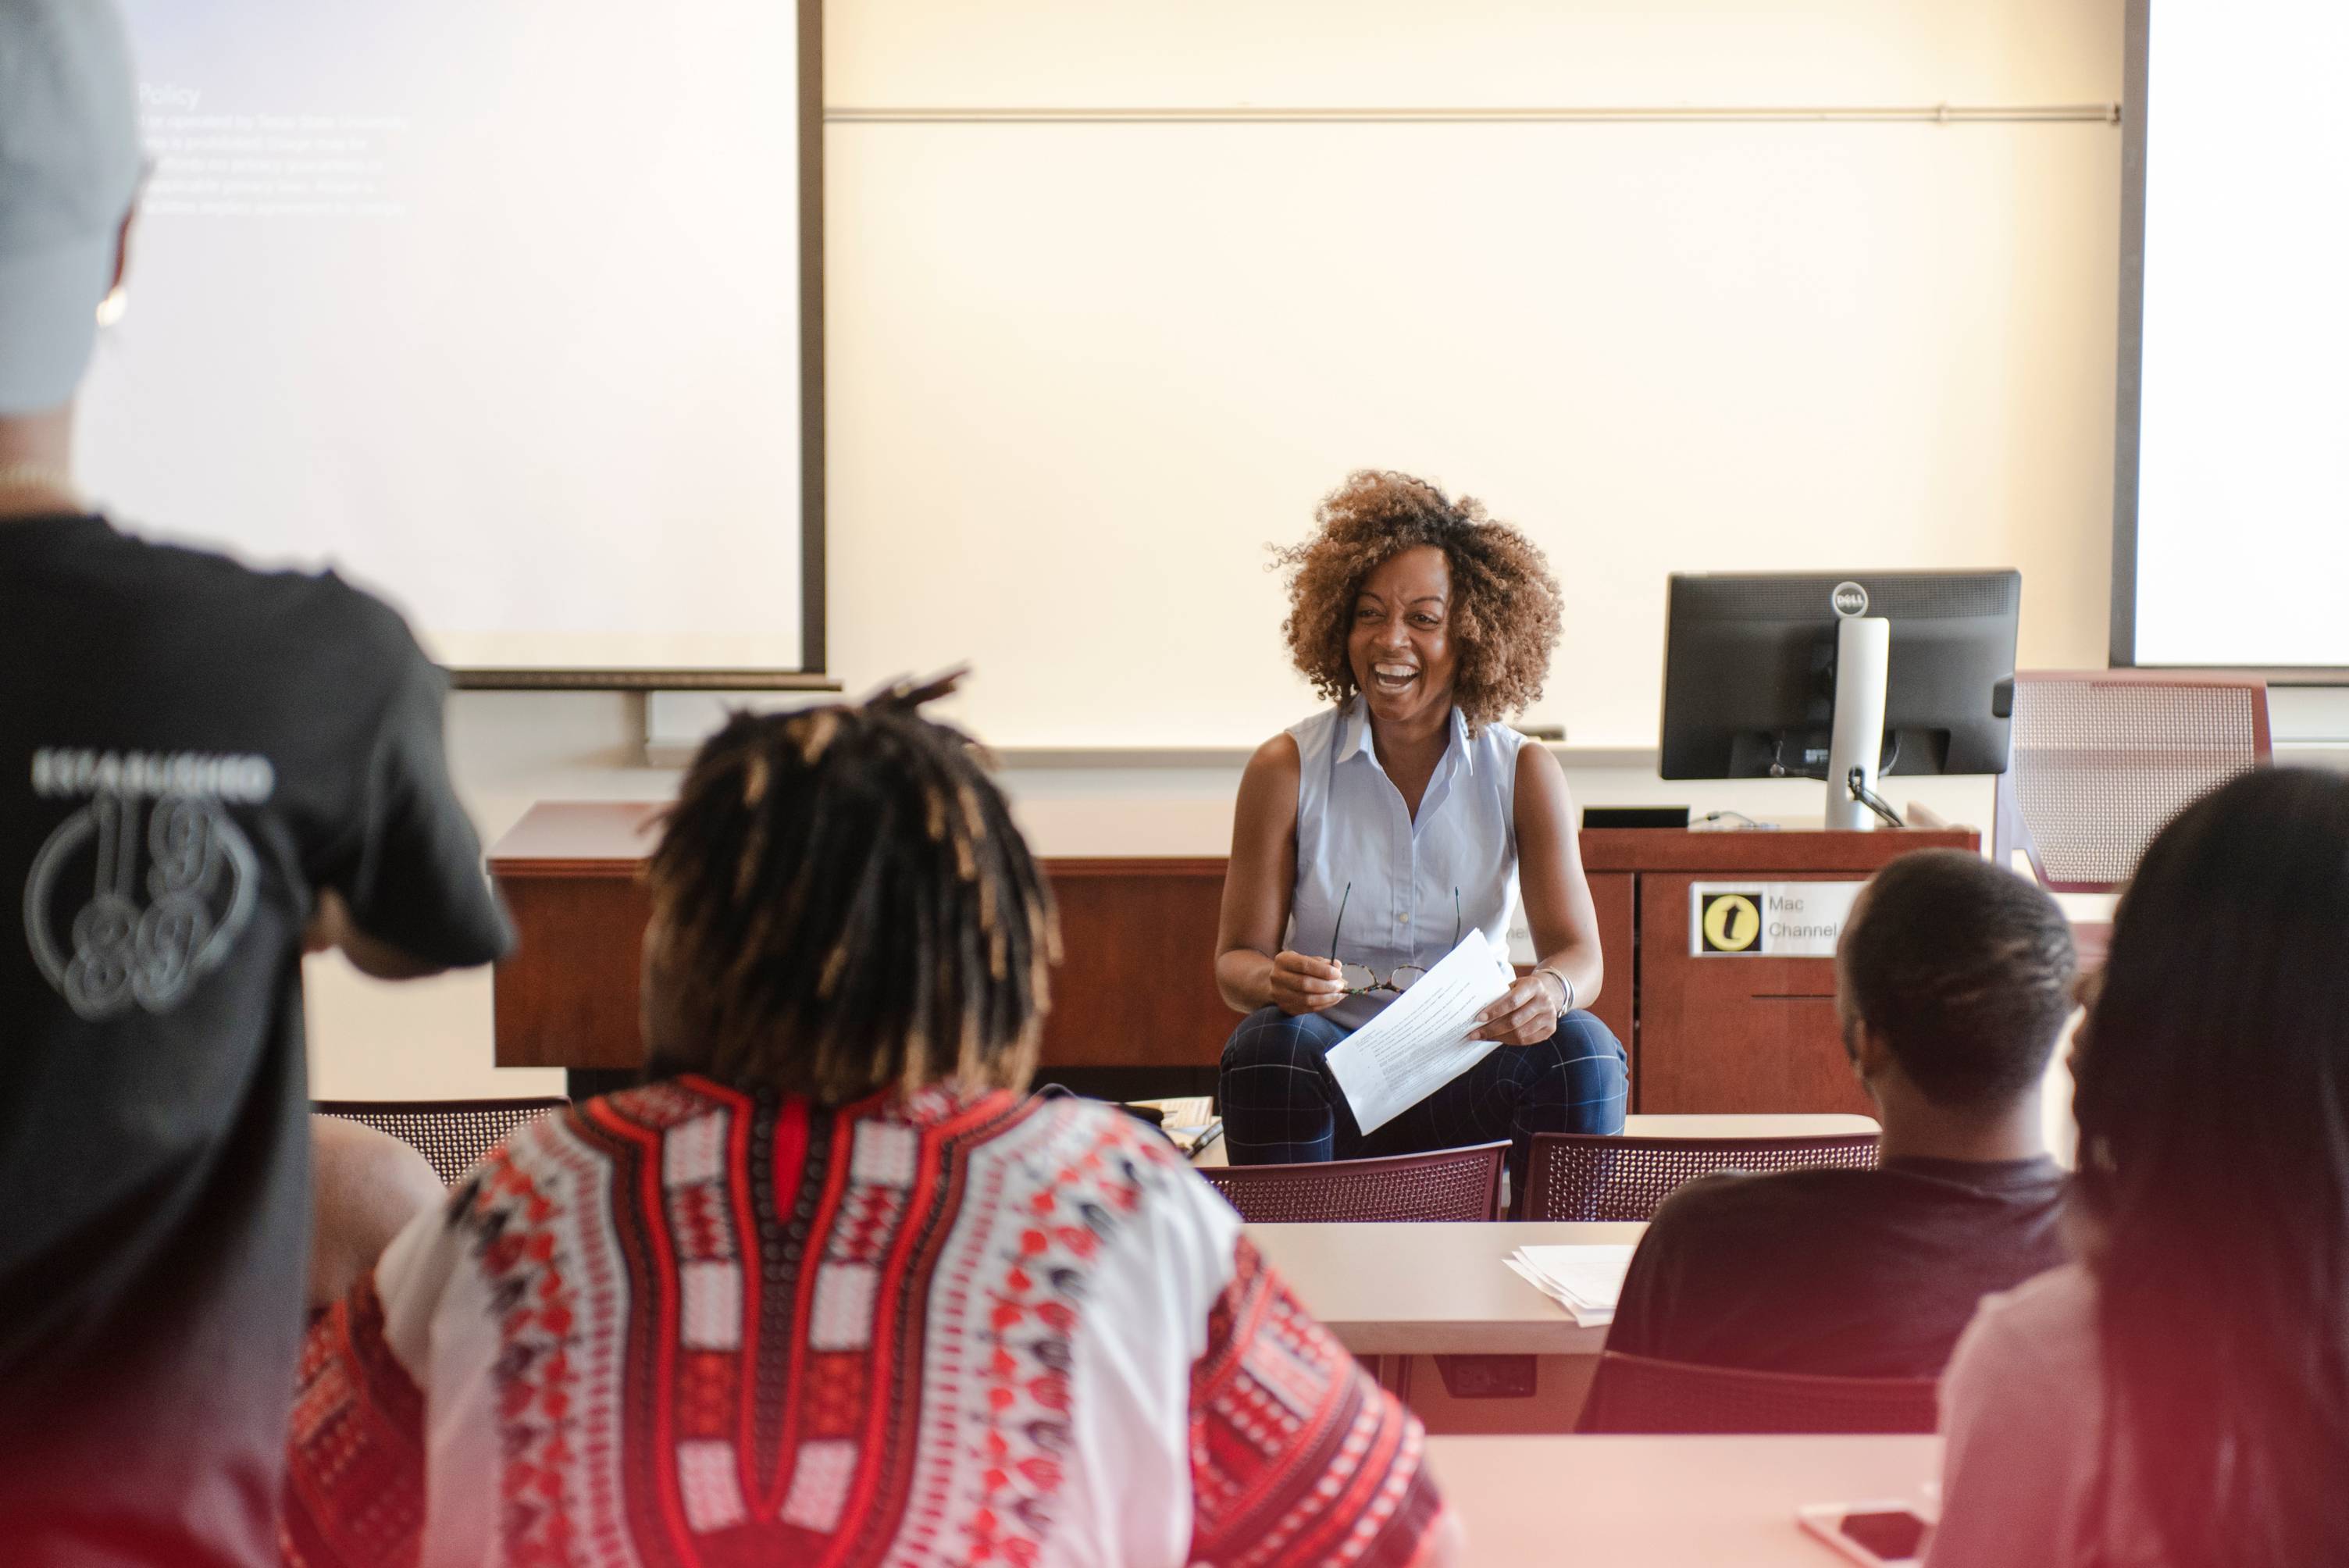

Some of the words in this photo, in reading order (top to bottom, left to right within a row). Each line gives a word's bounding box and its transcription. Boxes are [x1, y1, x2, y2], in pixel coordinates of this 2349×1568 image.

[139, 82, 201, 111] Policy
[1836, 593, 1864, 608] DELL
[1768, 896, 1805, 912] Mac
[1768, 921, 1837, 938] Channel
